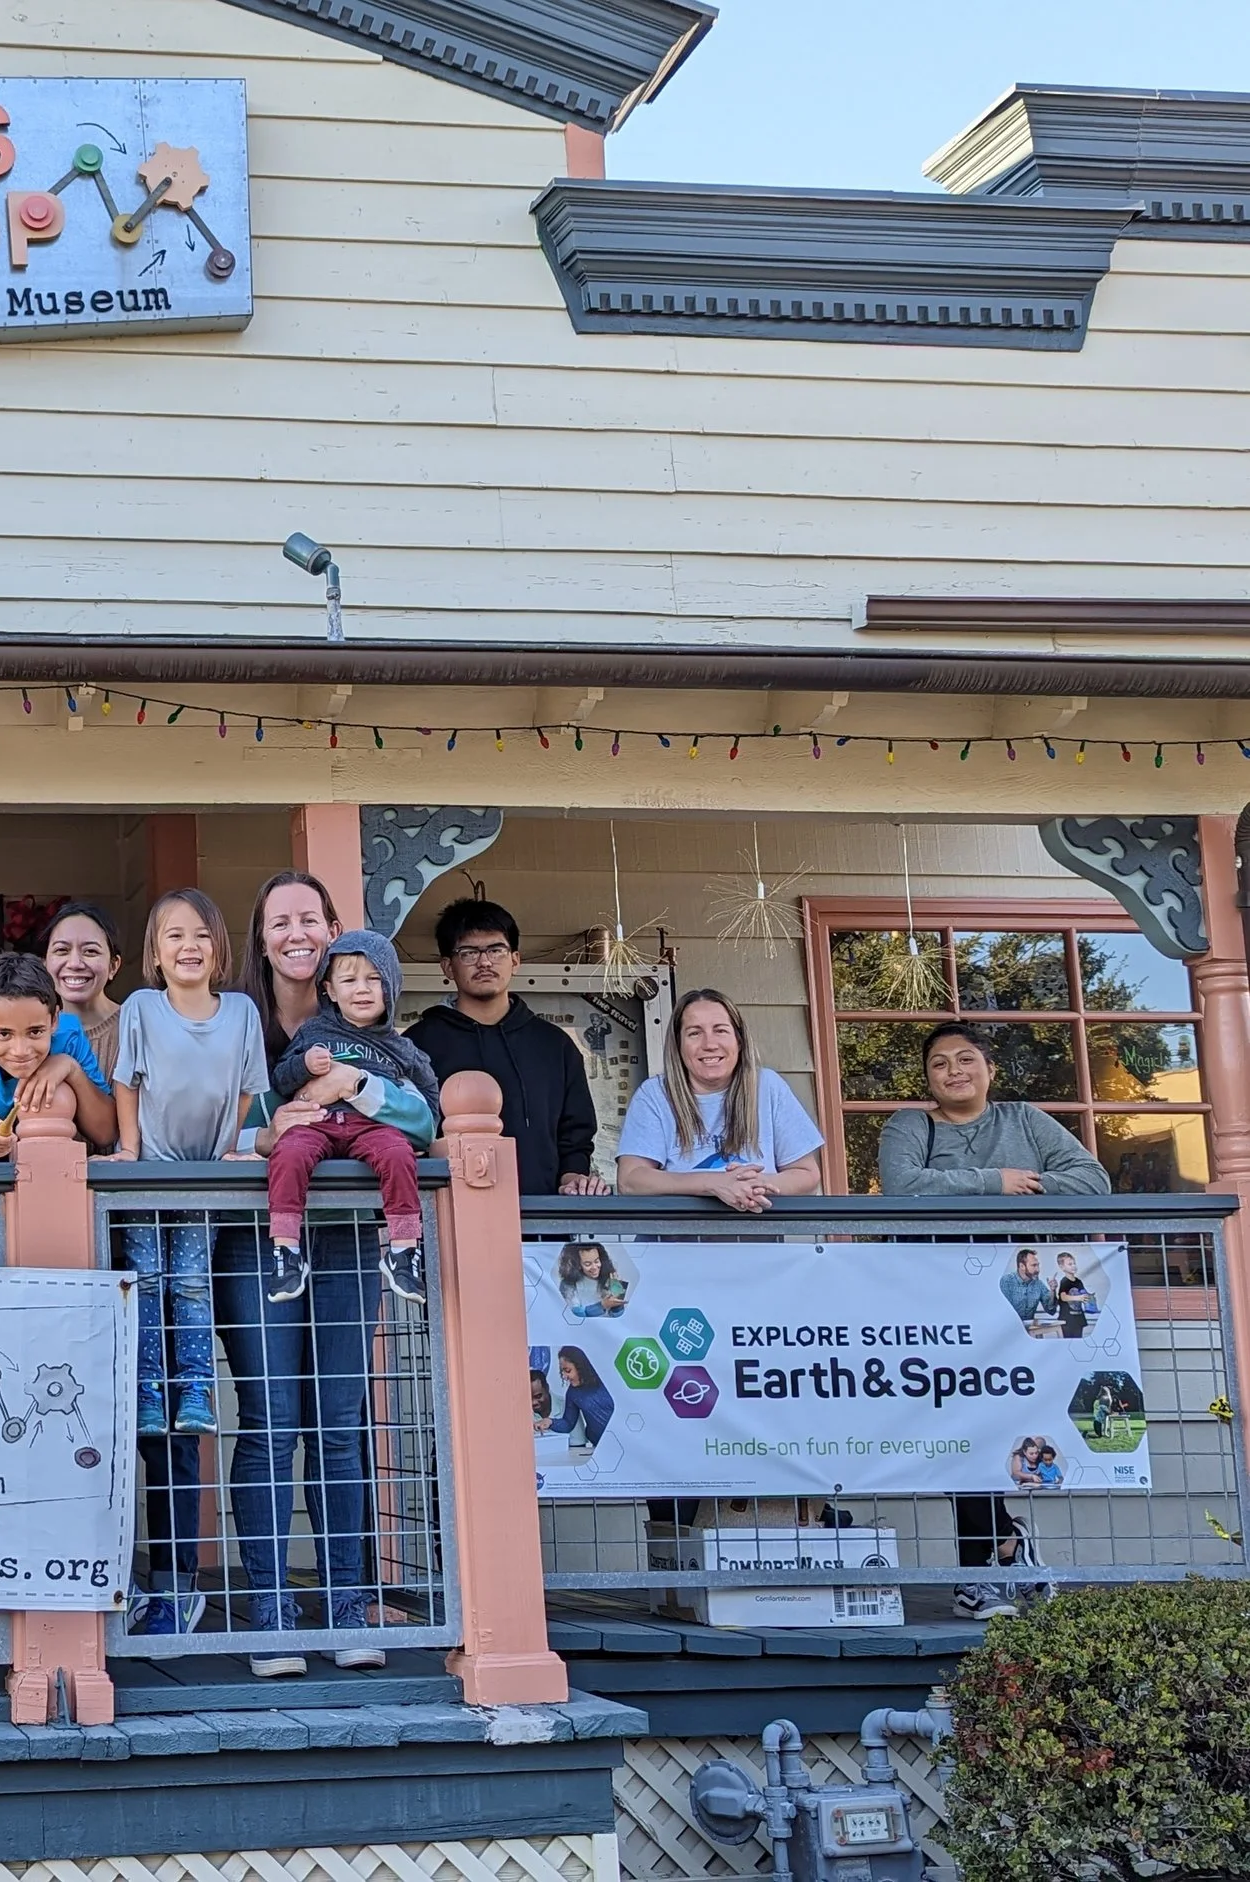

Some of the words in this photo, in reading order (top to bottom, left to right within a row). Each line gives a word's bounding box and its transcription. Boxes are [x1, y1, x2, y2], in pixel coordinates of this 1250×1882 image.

[7, 284, 172, 316] Museum
[732, 1325, 850, 1347] EXPLORE
[861, 1324, 973, 1345] SCIENCE
[735, 1357, 1035, 1407] Earth&Space
[704, 1437, 800, 1456] Hands-on
[806, 1437, 837, 1455] fun
[846, 1436, 873, 1454] for
[880, 1439, 970, 1458] everyone
[1114, 1466, 1135, 1474] NISE
